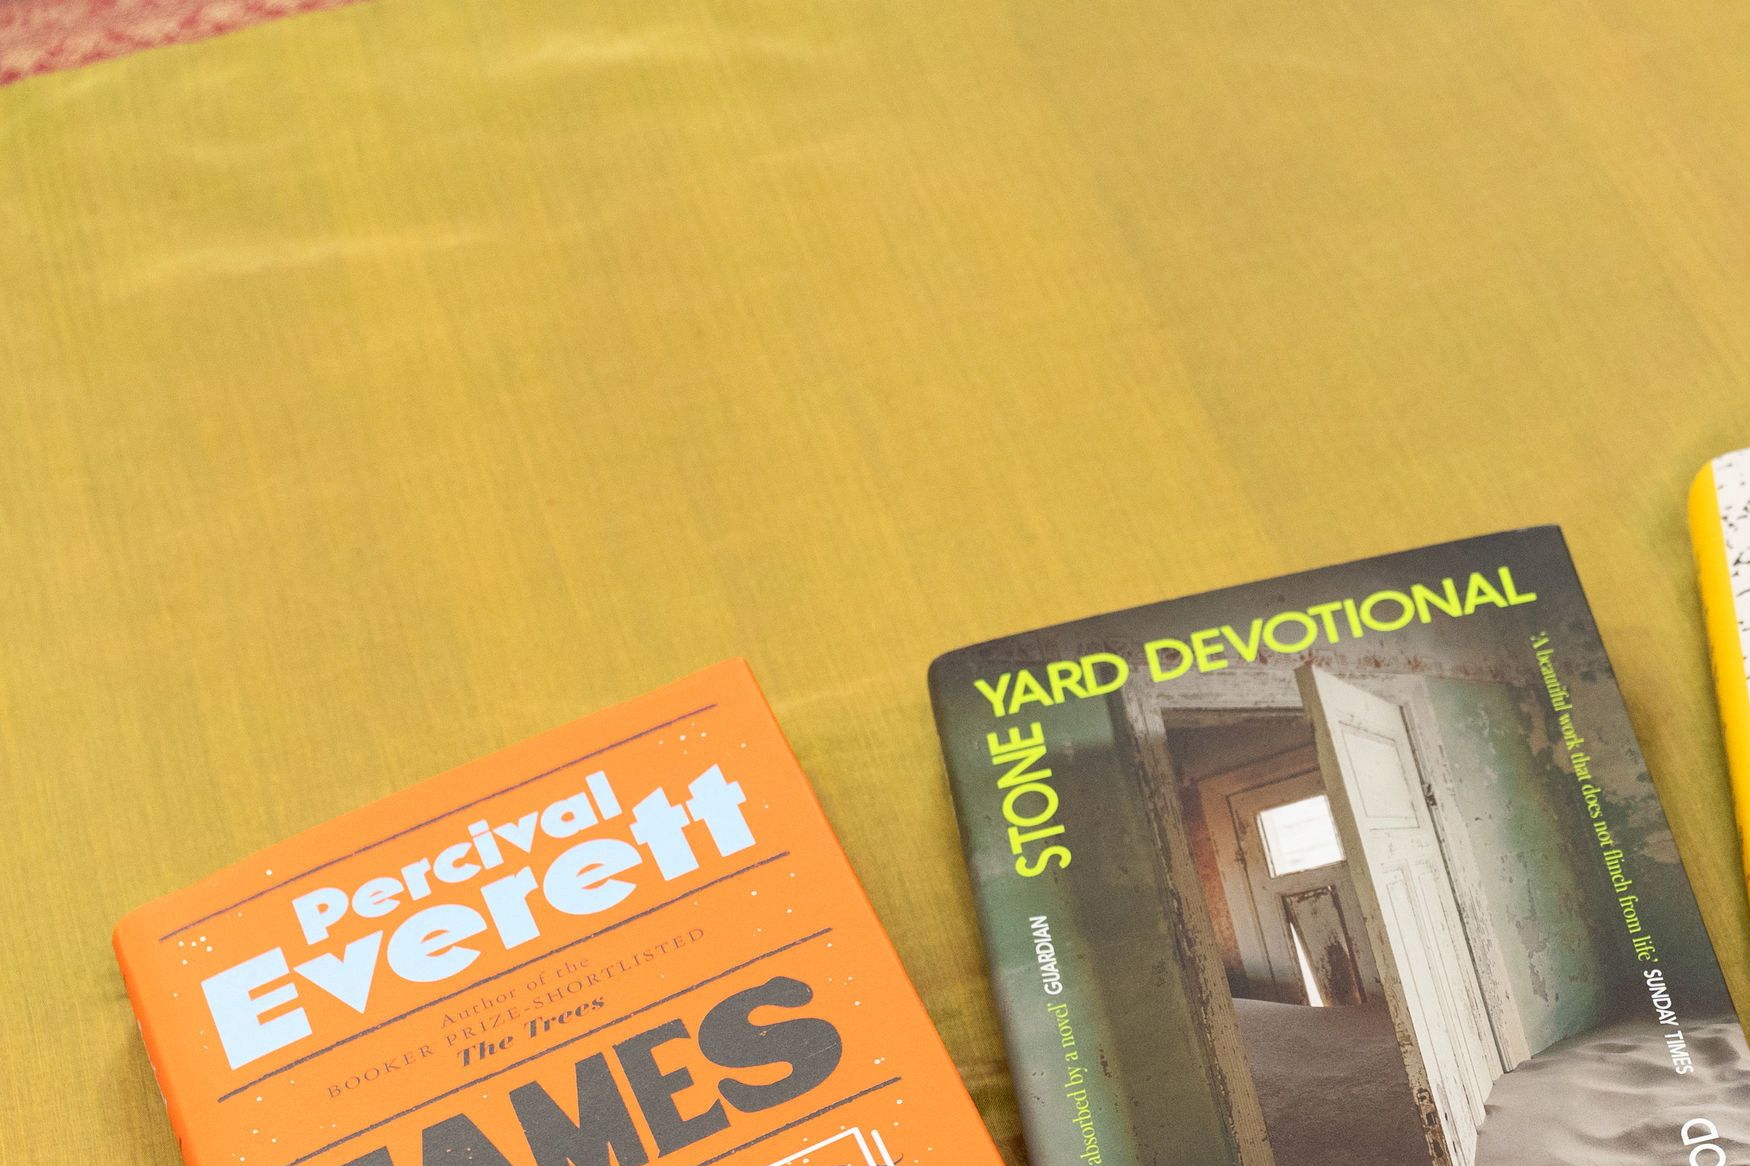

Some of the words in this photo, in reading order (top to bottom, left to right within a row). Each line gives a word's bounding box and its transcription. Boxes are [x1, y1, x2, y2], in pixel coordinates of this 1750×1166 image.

[974, 653, 1130, 718] YARD
[1143, 566, 1537, 683] DEVOTIONAL
[1535, 649, 1573, 711] beautiful
[1558, 712, 1585, 751] work
[1570, 752, 1592, 781] that
[987, 721, 1072, 878] STONE
[1581, 784, 1603, 819] does
[291, 770, 623, 946] Percival
[1593, 820, 1615, 847] not
[1603, 849, 1633, 893] flinch
[201, 763, 757, 1071] Everett
[1618, 895, 1642, 934] from
[1029, 915, 1063, 997] GUARDIAN
[326, 1043, 436, 1100] BOOKER
[445, 926, 706, 1047] PRIZE-SHORTLISTED
[440, 986, 518, 1028] Author
[526, 969, 549, 993] of
[552, 955, 591, 981] the
[1643, 969, 1679, 1026] SUNDAY
[456, 1034, 514, 1068] The
[523, 993, 606, 1042] Trees
[1064, 1050, 1079, 1061] a
[1664, 1030, 1694, 1075] TIMES
[1064, 1066, 1089, 1088] by
[1066, 1089, 1102, 1166] absorbed
